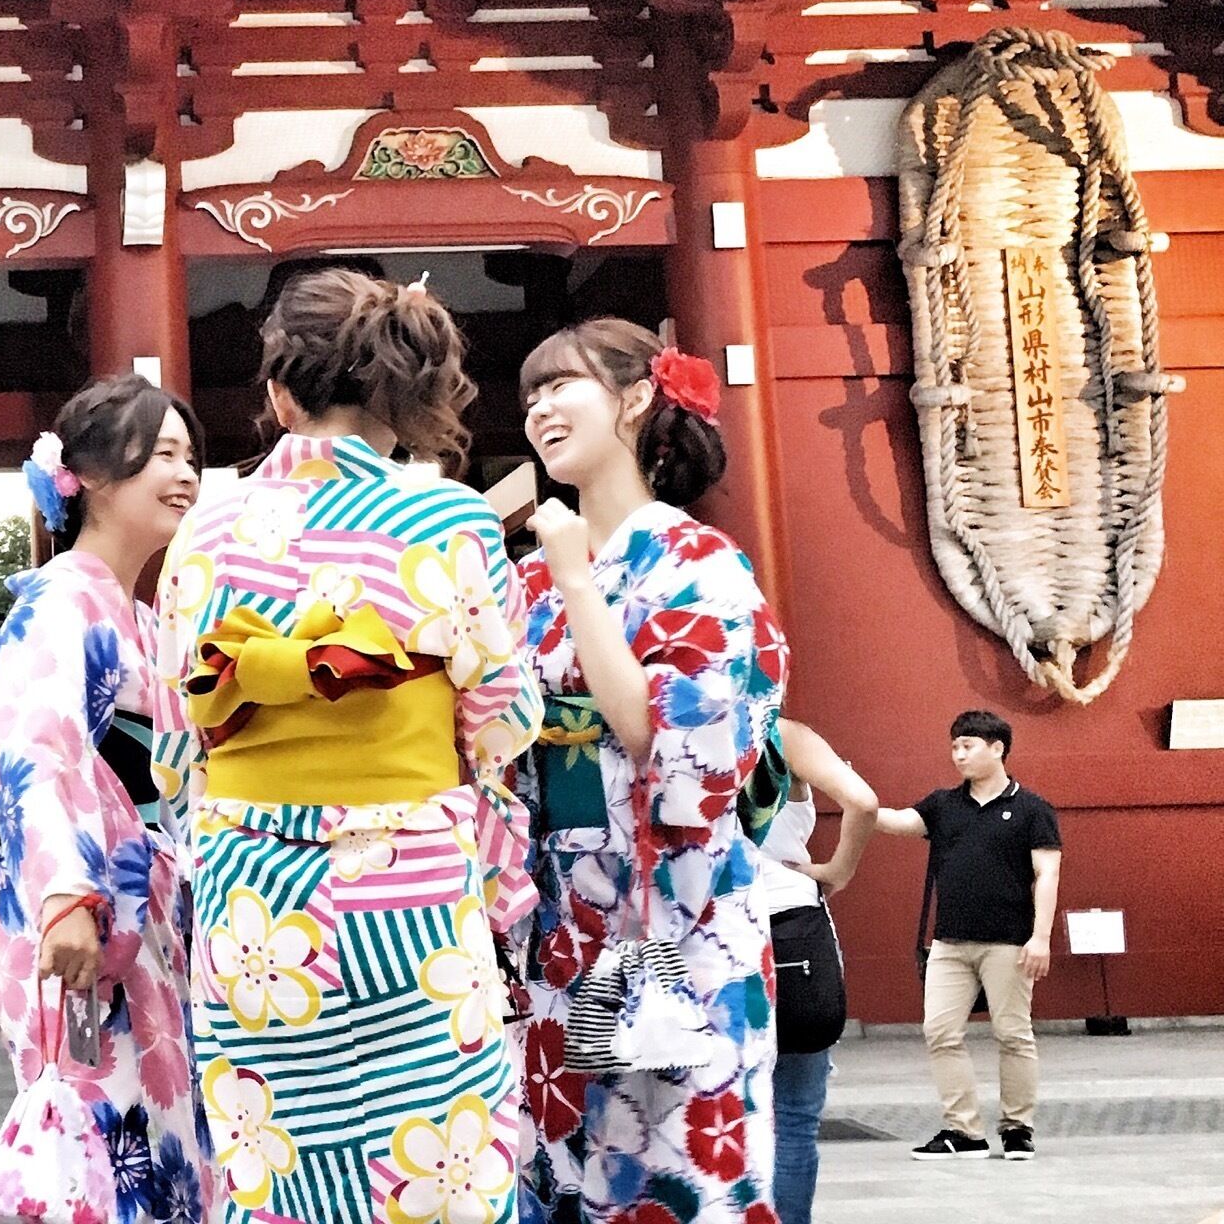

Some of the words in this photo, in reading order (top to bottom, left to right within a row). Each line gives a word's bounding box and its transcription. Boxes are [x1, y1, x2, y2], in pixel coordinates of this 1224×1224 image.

[1017, 276, 1062, 500] 山形県村山市奉賛会
